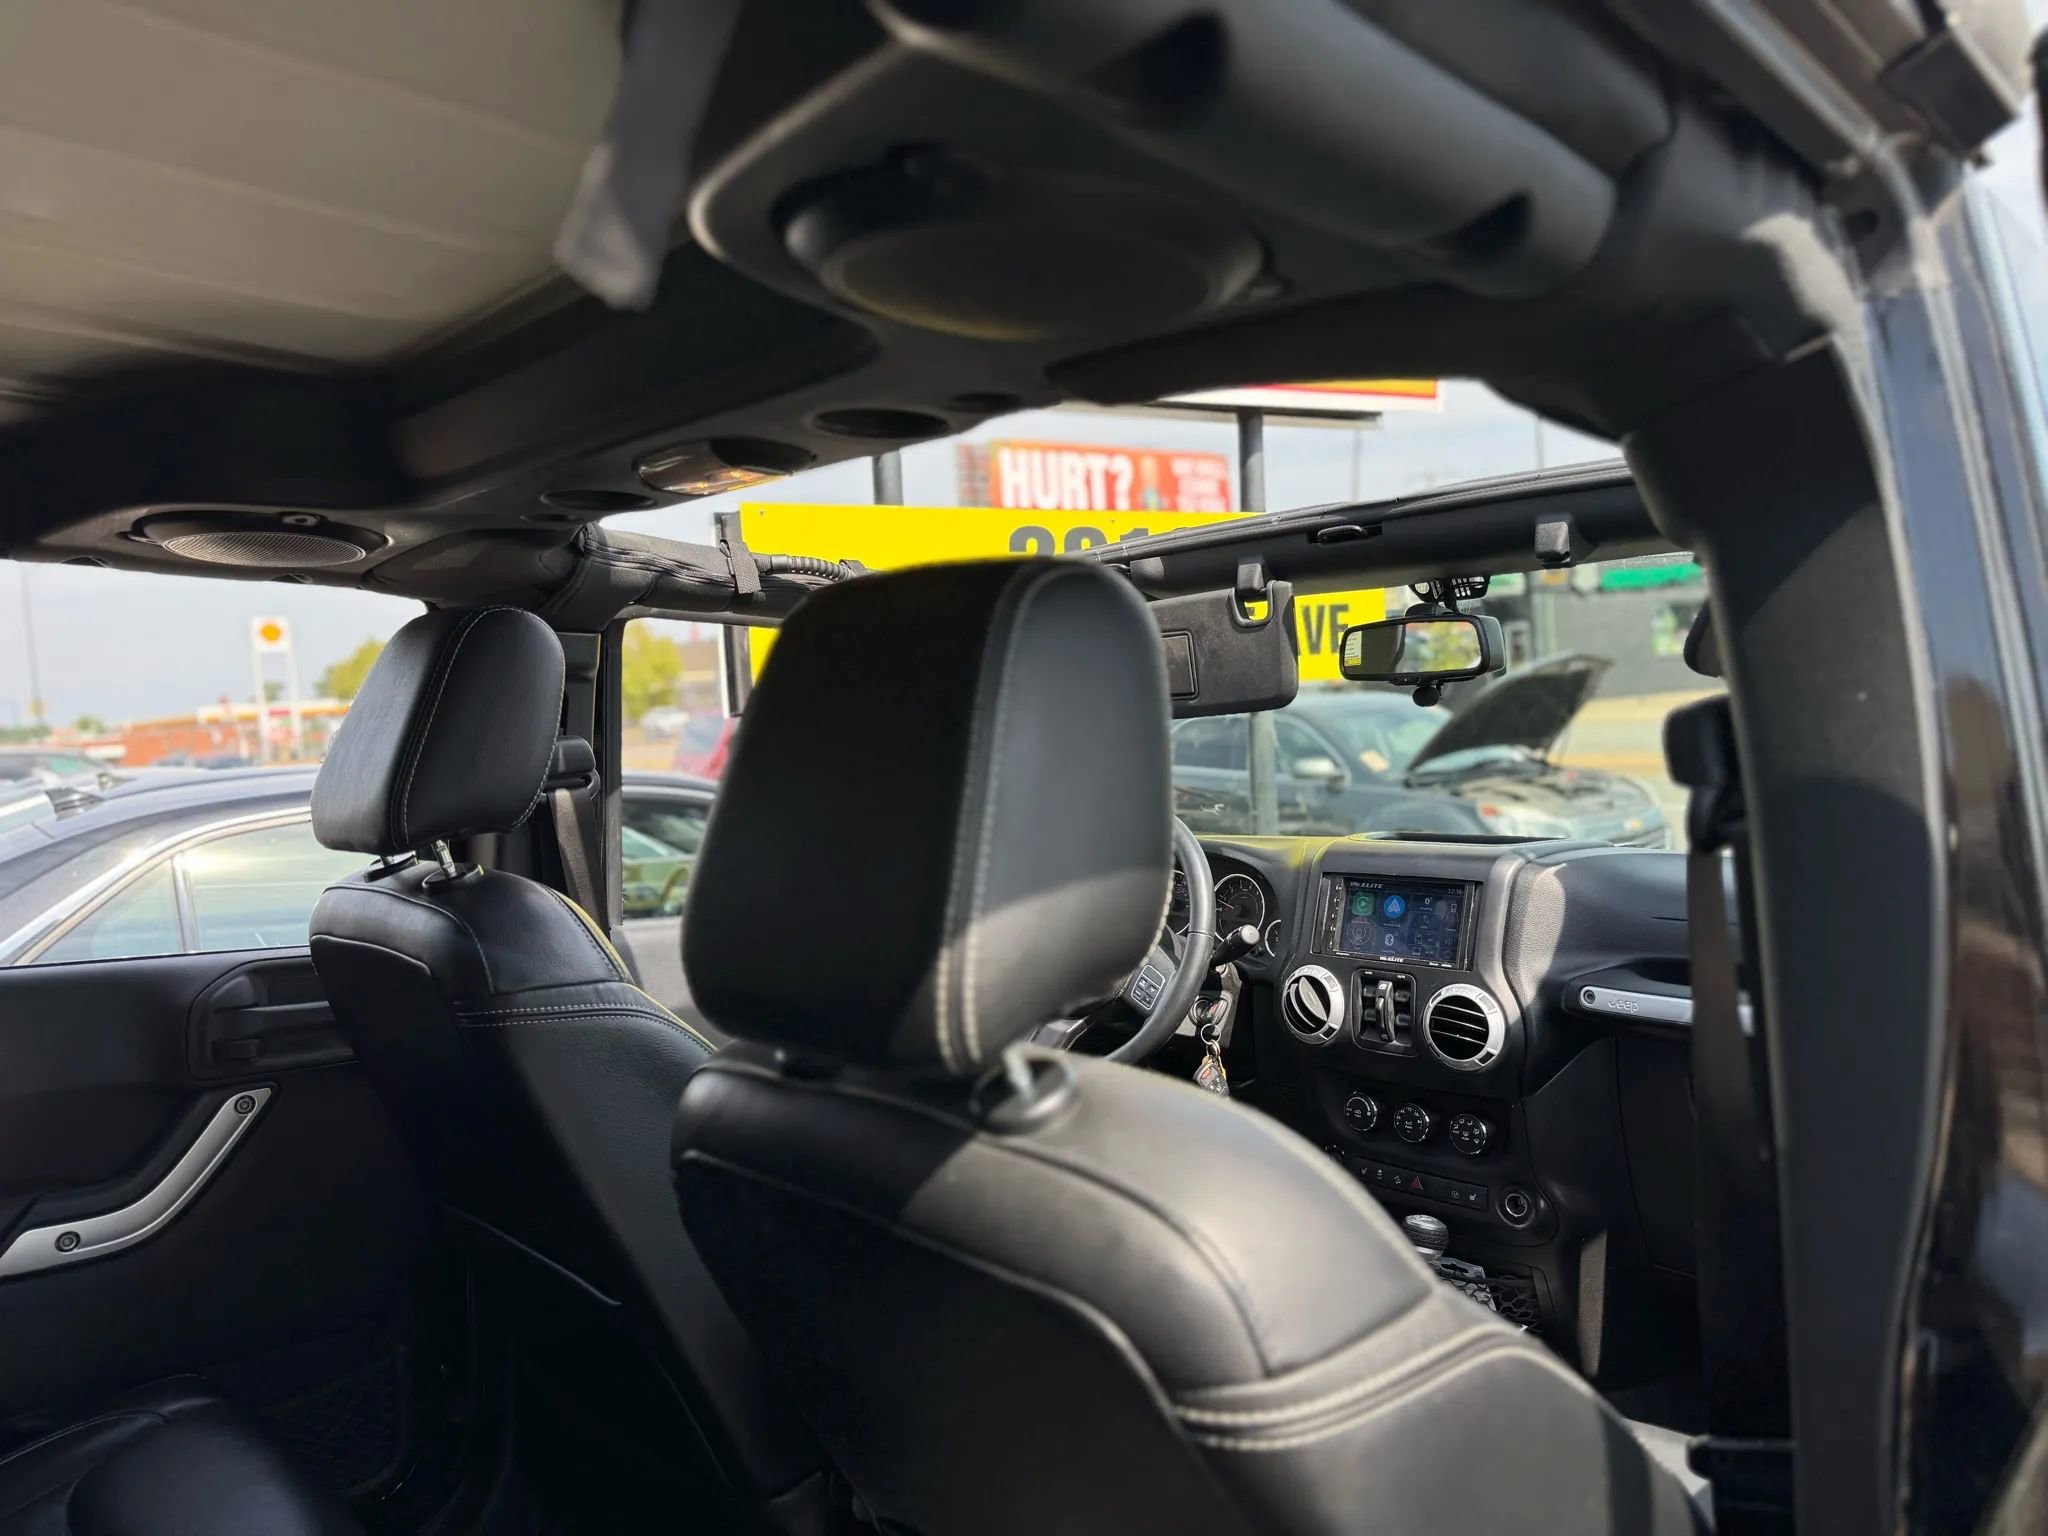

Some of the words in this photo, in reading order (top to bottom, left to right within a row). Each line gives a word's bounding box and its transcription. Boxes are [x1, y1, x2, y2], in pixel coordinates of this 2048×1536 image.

[999, 448, 1133, 510] HURT?
[1299, 603, 1350, 656] VE
[1608, 994, 1639, 1014] Jeep
